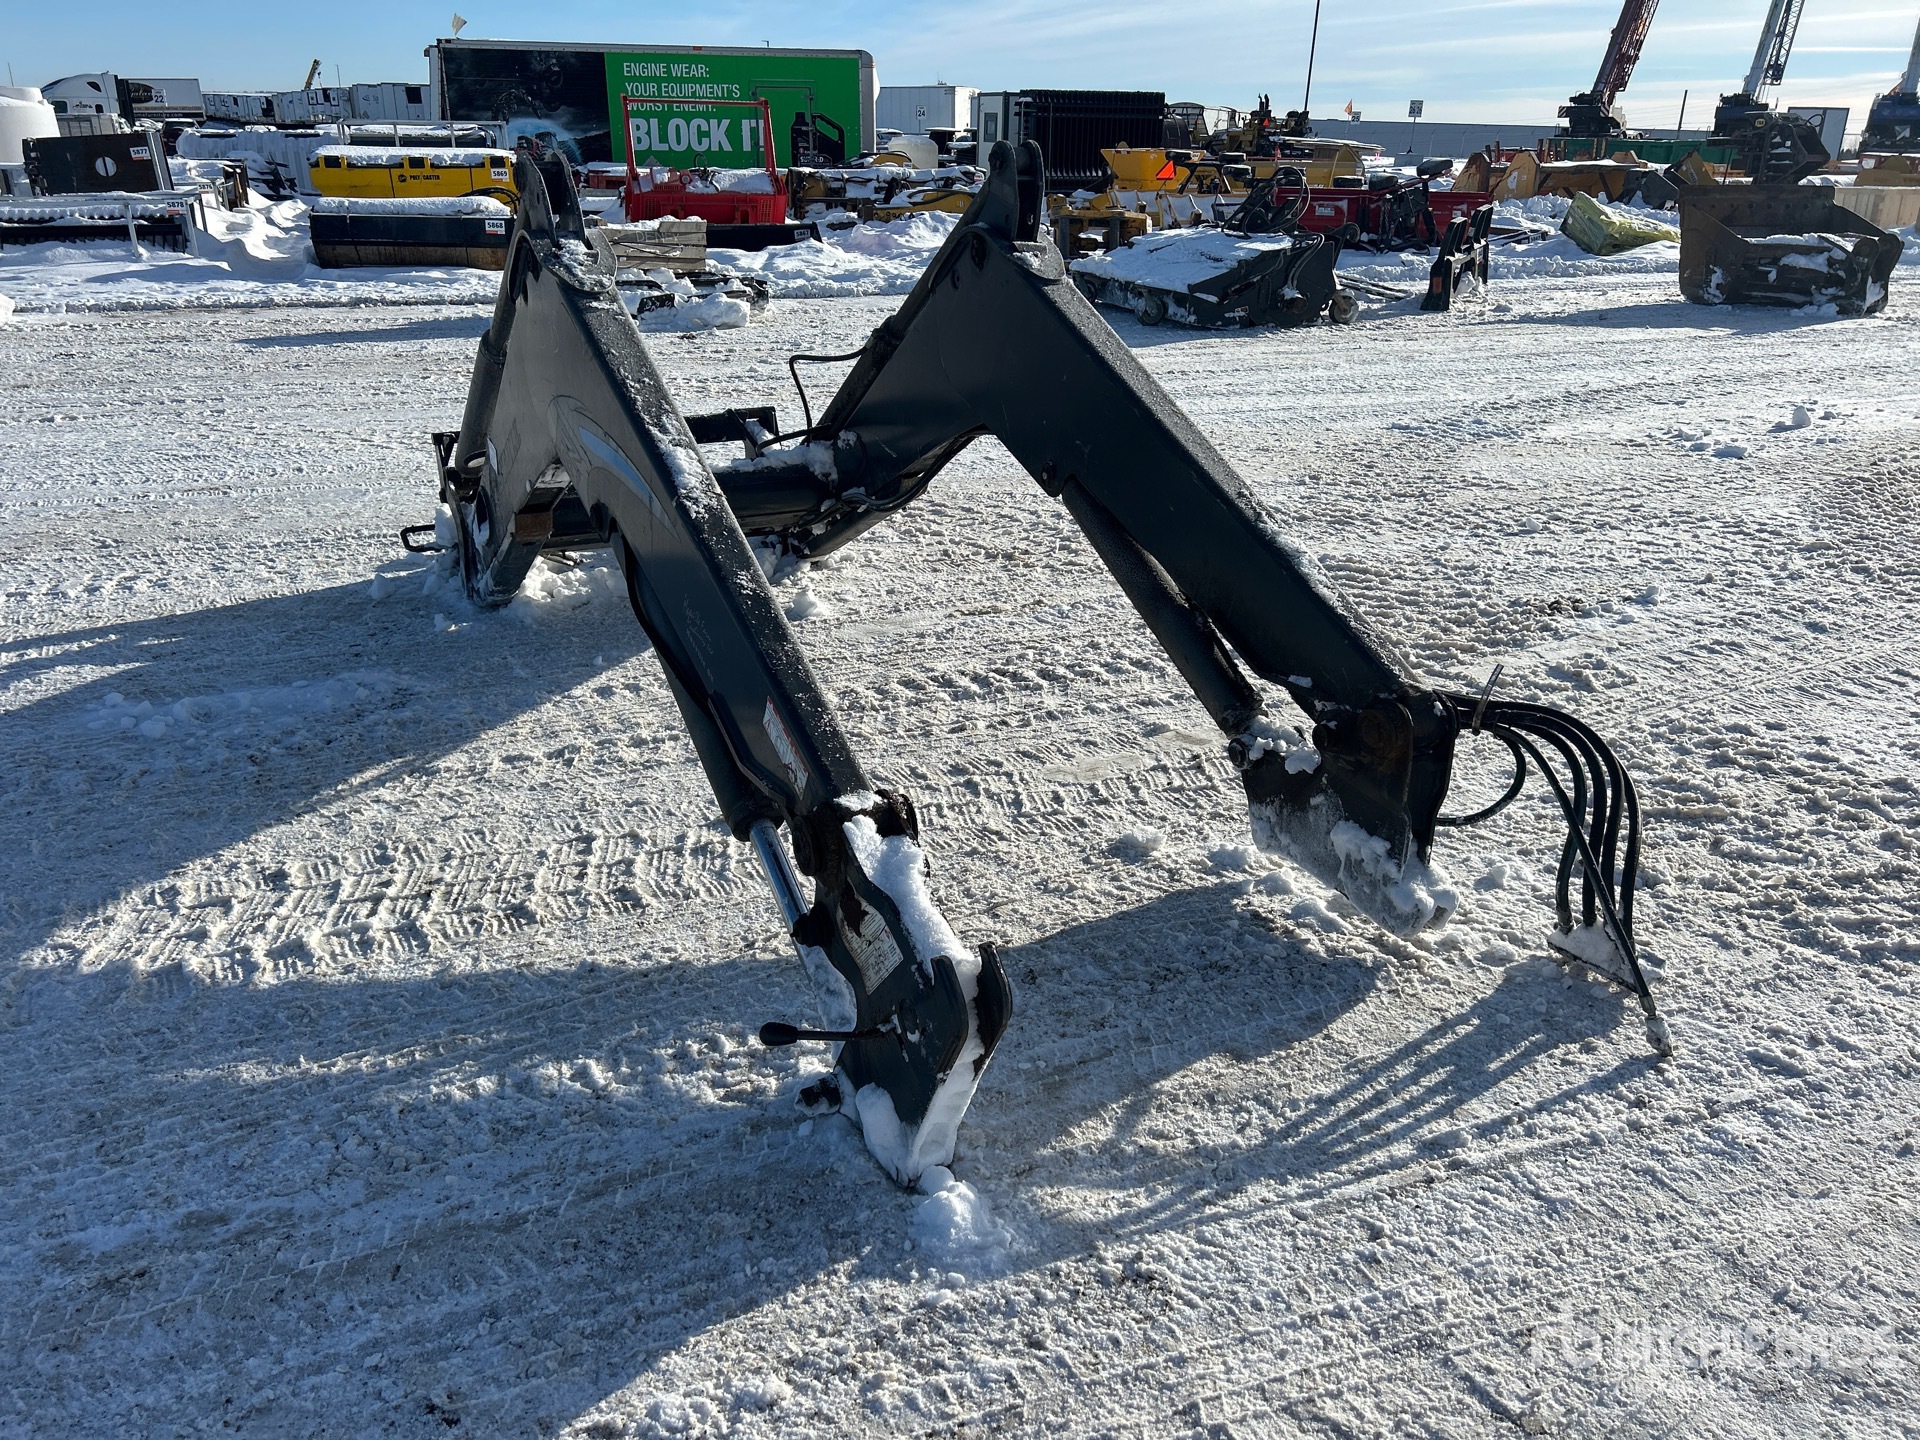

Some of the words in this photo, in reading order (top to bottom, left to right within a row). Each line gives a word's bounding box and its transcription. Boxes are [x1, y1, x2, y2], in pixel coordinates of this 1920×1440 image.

[623, 62, 668, 77] ENGINE
[670, 64, 710, 78] WEAR:
[625, 82, 658, 97] YOUR
[661, 83, 740, 98] EQUIPMENT'S
[154, 95, 165, 103] 22
[628, 99, 668, 111] WORST
[917, 109, 926, 117] 24
[629, 117, 733, 152] BLOCK
[487, 221, 504, 229] 5868
